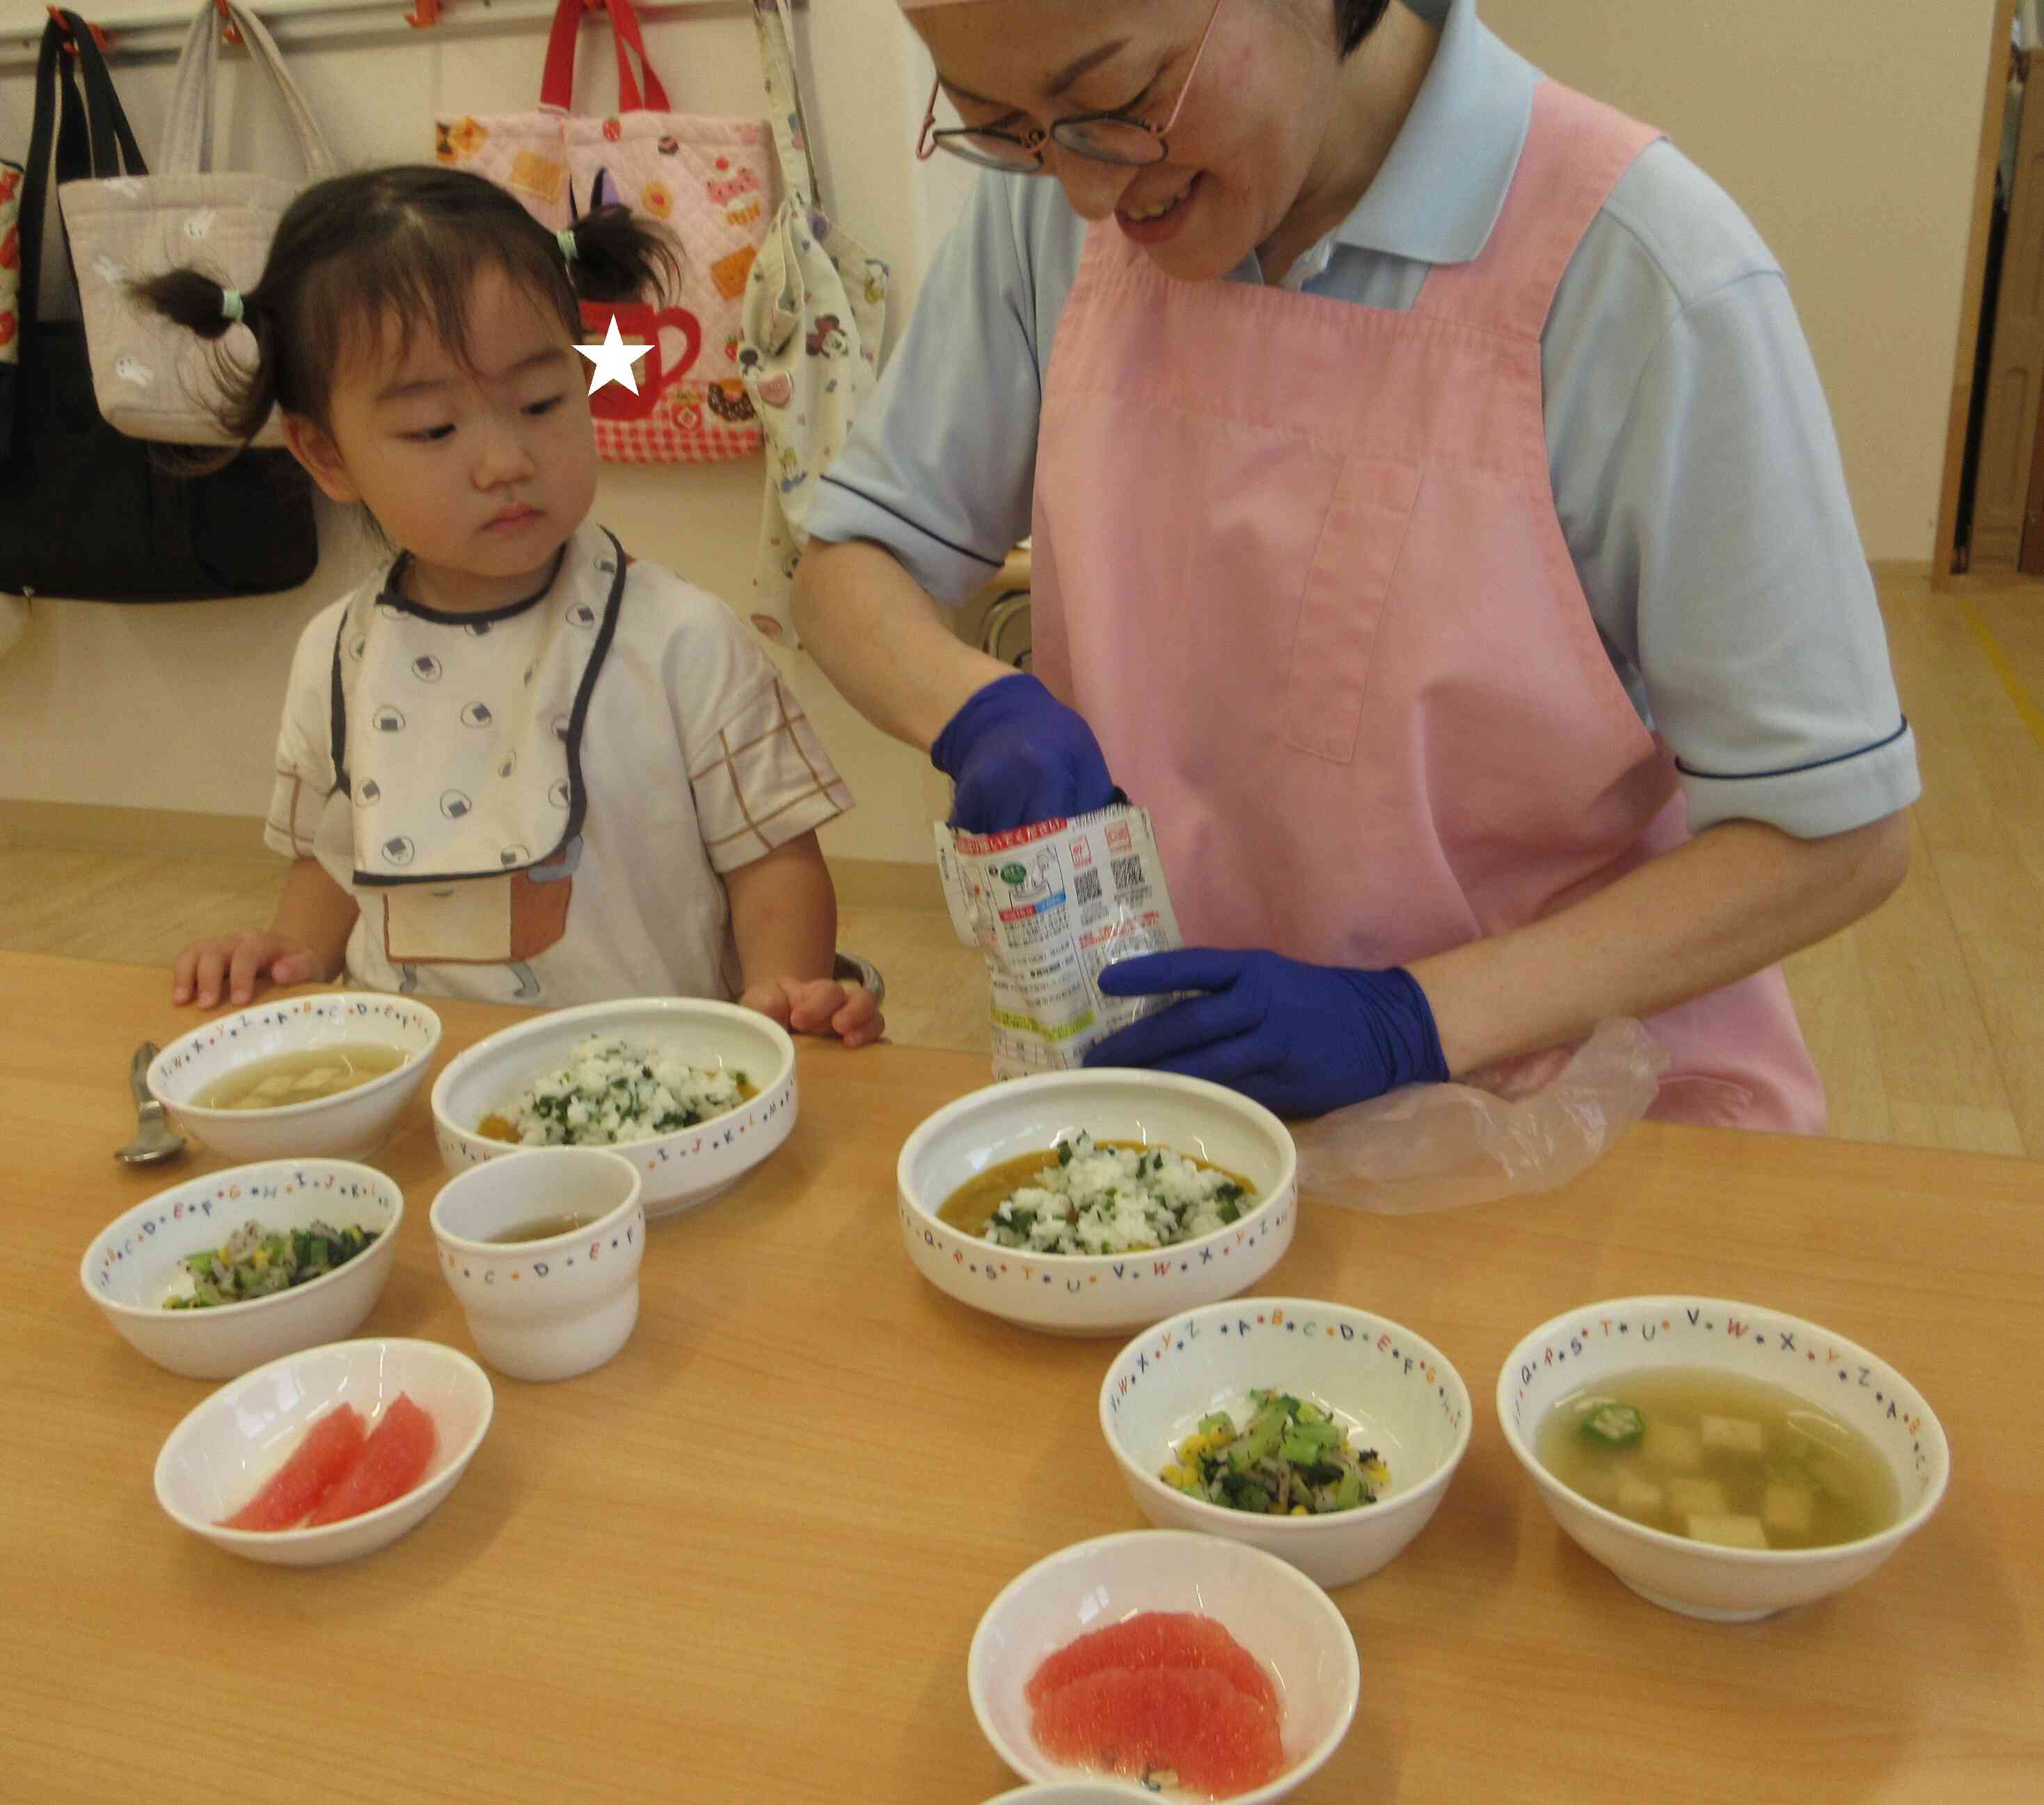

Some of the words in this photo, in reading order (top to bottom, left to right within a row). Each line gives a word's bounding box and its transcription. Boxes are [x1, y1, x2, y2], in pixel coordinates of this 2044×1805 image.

[356, 1002, 367, 1014] D
[691, 1139, 702, 1153] J
[143, 1221, 156, 1235] D
[324, 1175, 335, 1189] J
[484, 1270, 496, 1284] C
[533, 1262, 548, 1277] D
[924, 1229, 935, 1246] Q
[1022, 1266, 1035, 1281] T
[1067, 1279, 1081, 1293] U
[1113, 1263, 1124, 1279] V
[1154, 1261, 1171, 1276] W
[1199, 1247, 1212, 1265] X
[1236, 1231, 1246, 1245] Y
[1118, 1375, 1127, 1396] W
[1162, 1334, 1171, 1349] Y
[1239, 1319, 1251, 1336] A
[1271, 1309, 1283, 1326] B
[1304, 1322, 1316, 1337] C
[1340, 1323, 1354, 1341] D
[1377, 1334, 1391, 1353] E
[1521, 1366, 1532, 1385] Q
[1545, 1348, 1554, 1366] R
[1570, 1337, 1582, 1356] S
[1600, 1318, 1613, 1337] T
[1642, 1325, 1656, 1341] U
[1687, 1308, 1700, 1326] V
[1728, 1318, 1750, 1337] W
[1780, 1332, 1796, 1351] X
[1858, 1368, 1871, 1387] Z
[1887, 1400, 1896, 1419] A
